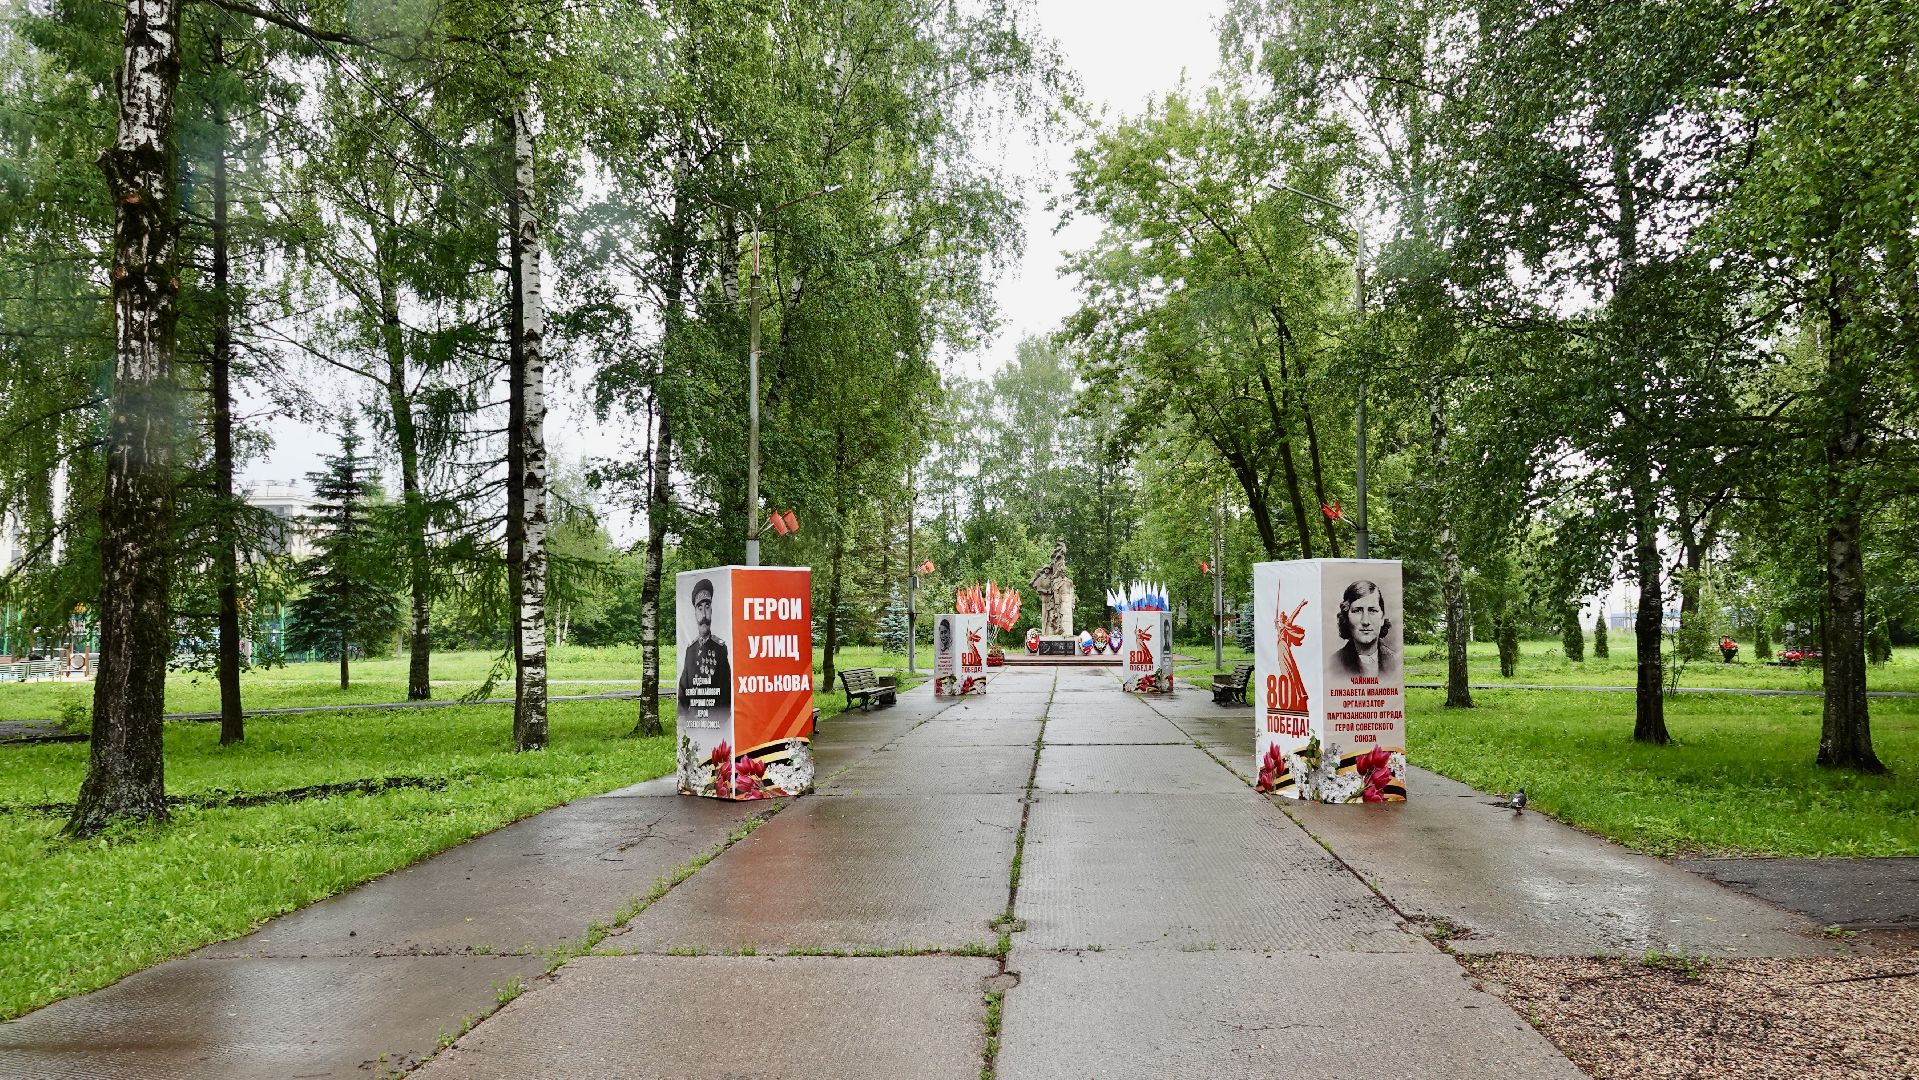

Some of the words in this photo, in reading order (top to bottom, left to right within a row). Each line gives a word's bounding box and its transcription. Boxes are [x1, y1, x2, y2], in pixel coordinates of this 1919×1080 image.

[743, 597, 802, 620] ГЕРОИ
[748, 634, 800, 661] УЛИЦ
[1130, 651, 1142, 663] 80
[738, 675, 810, 693] ХОТЬКОВА
[1350, 676, 1379, 684] ЧАЙКИНА
[1267, 675, 1288, 709] 80
[1330, 689, 1365, 697] ЕЛИЗАВЕТА
[1367, 688, 1399, 696] ИВАНОВНА
[1343, 700, 1385, 708] ОРГАНИЗАТОР
[1327, 712, 1378, 720] ПАРТИЗАНСКОГО
[1380, 711, 1403, 719] ОТРЯДА
[1267, 716, 1309, 738] ПОБЕДА!
[1335, 723, 1355, 731] ГЕРОЙ
[1356, 723, 1394, 731] СОВЕТСКОГО
